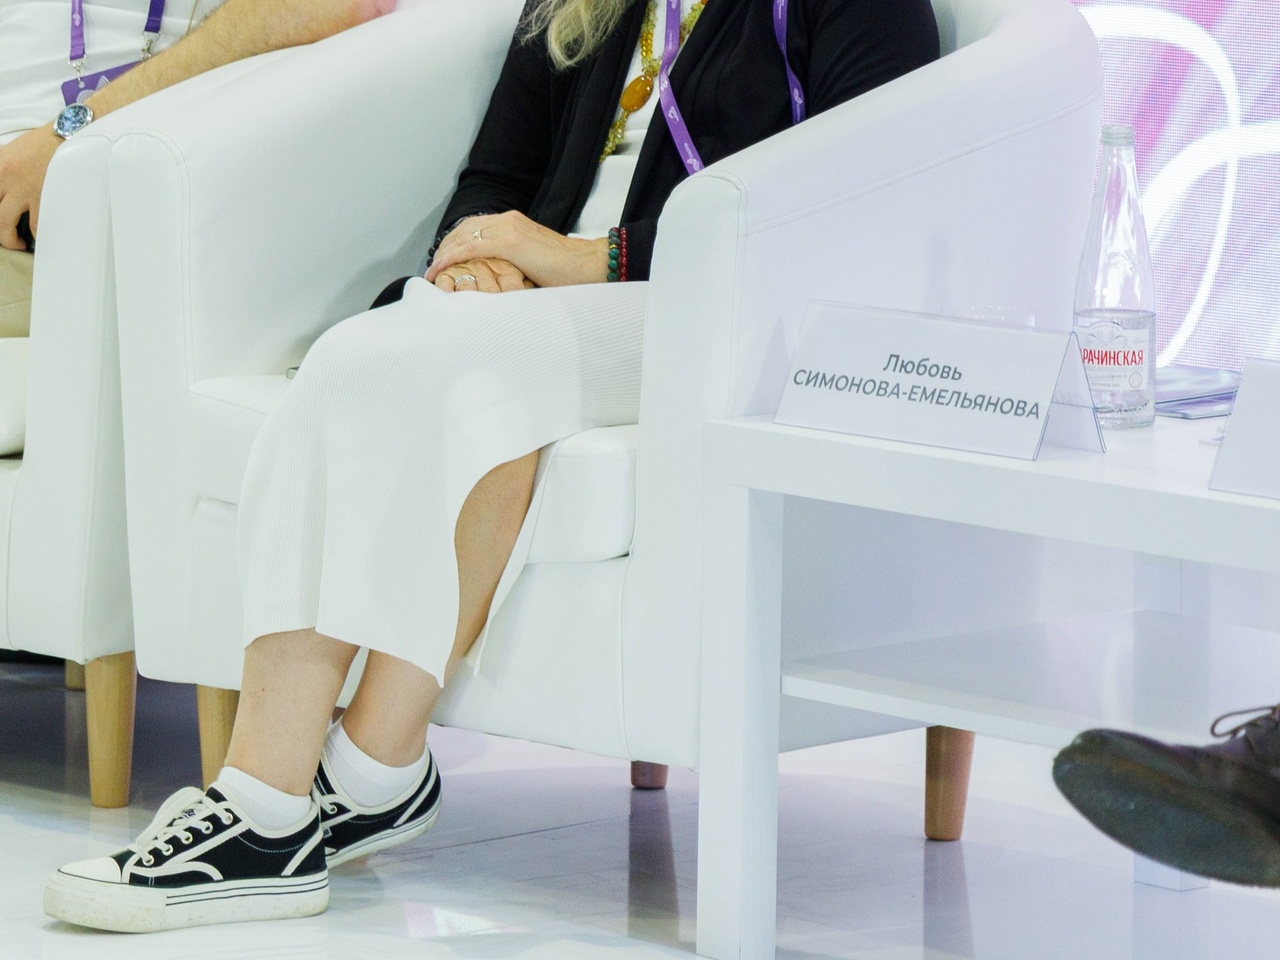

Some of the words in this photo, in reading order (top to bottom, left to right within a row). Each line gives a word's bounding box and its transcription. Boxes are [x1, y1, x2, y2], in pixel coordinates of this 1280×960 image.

[883, 353, 963, 381] Любовь
[1080, 348, 1144, 366] РАЧИНСКАЯ
[793, 369, 1040, 419] СИМОНОВА-ЕМЕЛЬЯНОВА
